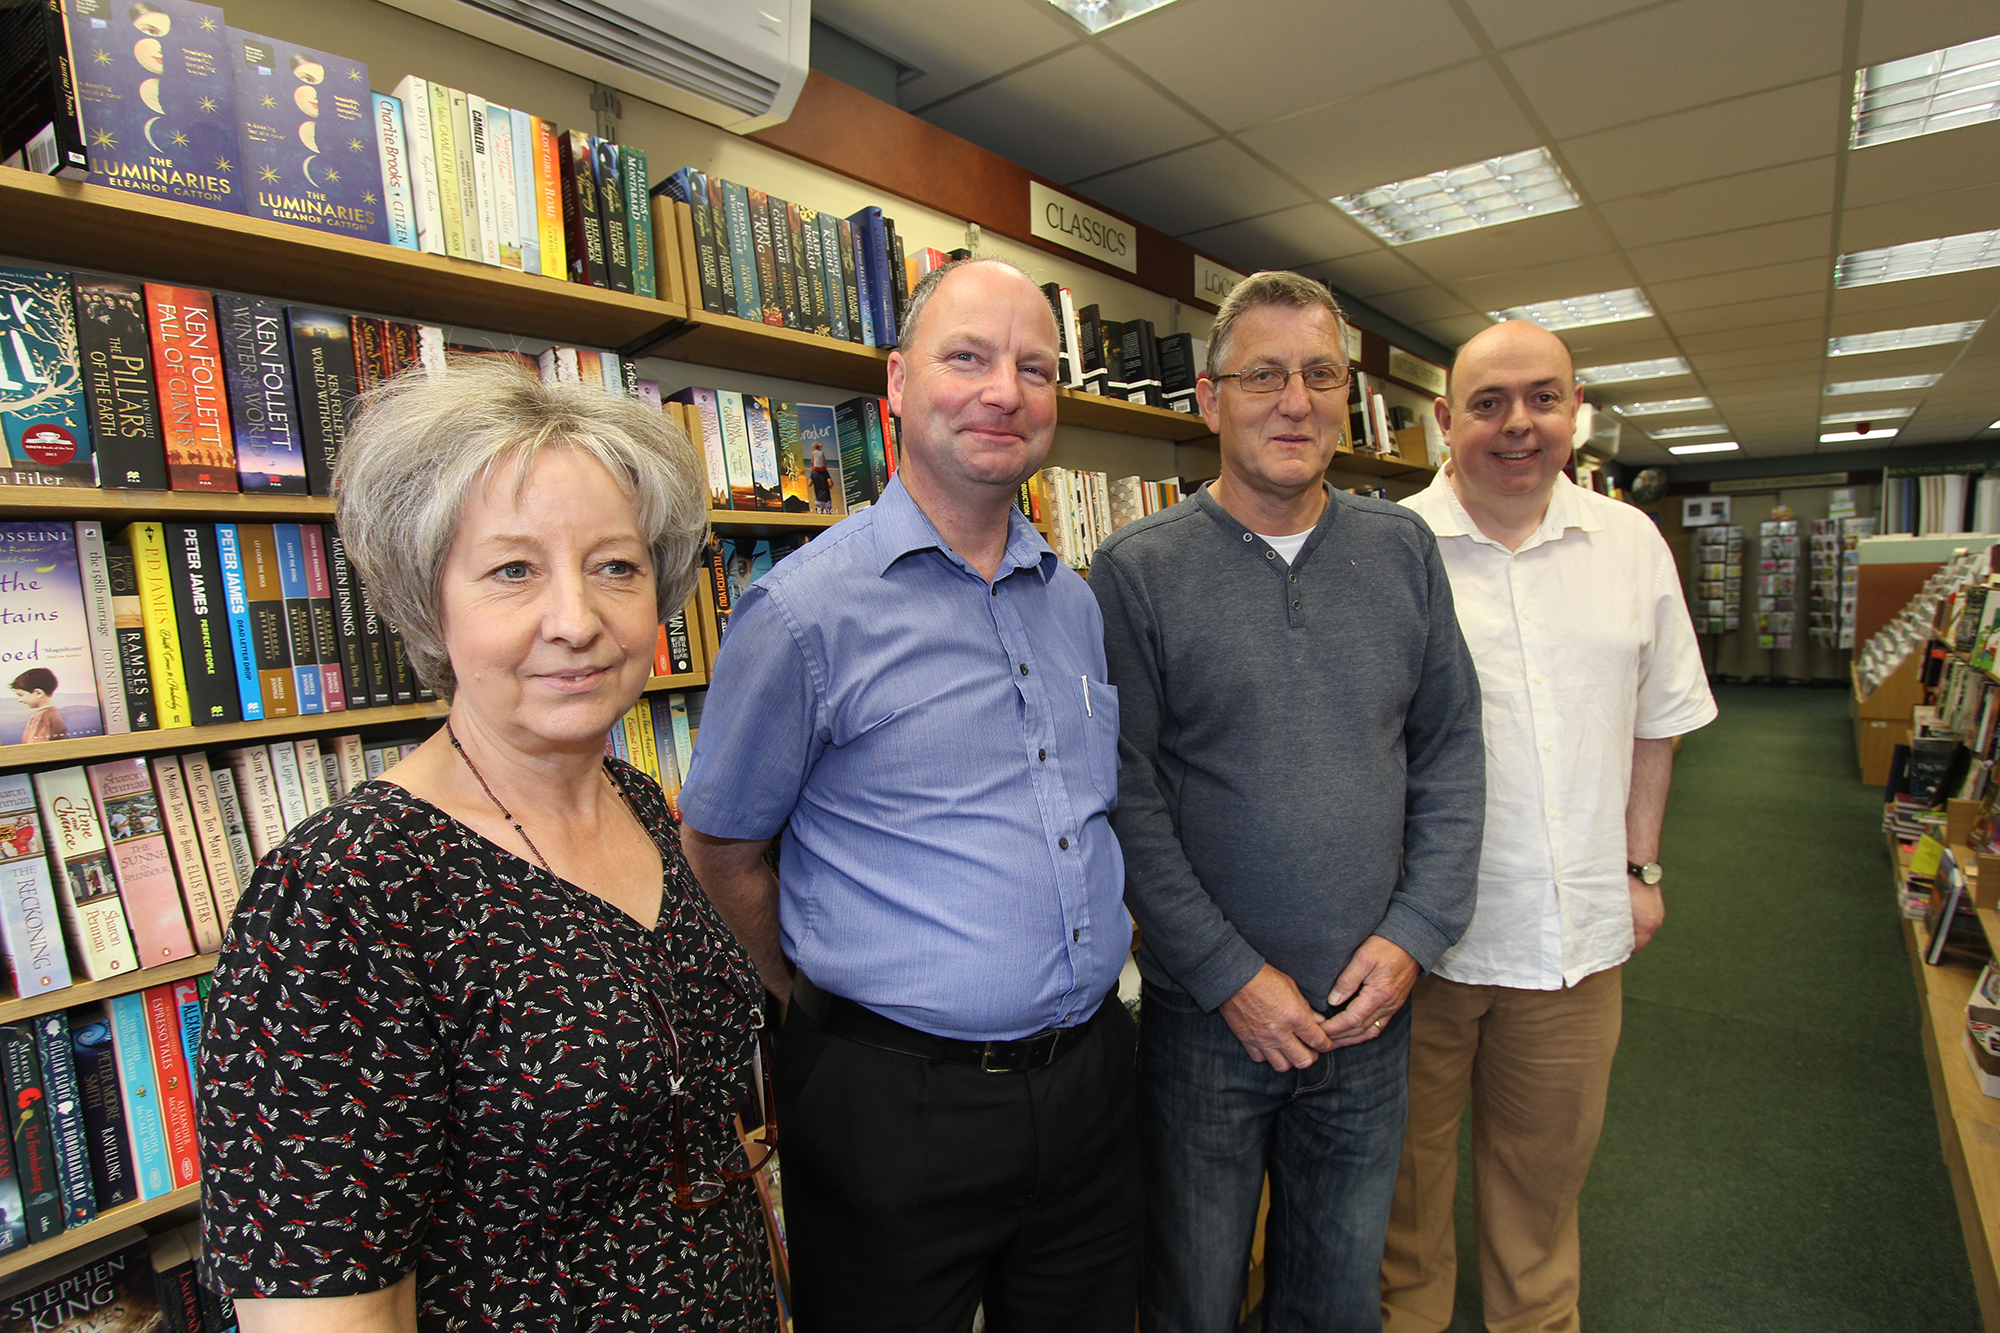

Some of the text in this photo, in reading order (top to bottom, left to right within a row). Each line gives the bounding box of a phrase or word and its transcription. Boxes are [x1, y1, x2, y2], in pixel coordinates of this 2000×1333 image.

[416, 106, 429, 142] BYATT
[472, 110, 485, 155] CAMILLERI
[93, 158, 232, 195] LUMINARIES
[148, 156, 173, 168] THE
[380, 100, 408, 244] Charlie Brooks CITIZEN
[541, 132, 556, 219] LOST GIRLS ROME
[109, 177, 222, 202] ELEANOR CATTON
[258, 191, 375, 225] LUMINARIES
[306, 190, 326, 202] THE
[627, 156, 640, 220] MONTABARD
[637, 170, 648, 217] FALCONS
[272, 208, 368, 232] ELEANOR CATTON
[584, 217, 594, 261] CHADWICK
[590, 217, 603, 265] ELIZABETH
[609, 220, 619, 263] CHADWICK
[729, 194, 743, 254] WHITE CASTLE
[737, 202, 747, 236] LORDS
[754, 220, 765, 253] KING
[761, 217, 771, 247] DEFY
[773, 208, 786, 264] COURAGE
[1046, 202, 1127, 256] CLASSICS
[615, 221, 626, 267] ELIZABETH
[635, 224, 645, 272] CHADWICK
[701, 245, 712, 285] CHADWICK
[804, 224, 816, 269] ENGLISH
[812, 230, 822, 260] LADY
[823, 229, 836, 276] KNIGHT
[707, 246, 717, 288] ELIZABETH
[740, 259, 750, 304] CHADWICK
[761, 257, 771, 302] CHADWICK
[233, 306, 257, 376] WINTER
[90, 351, 117, 437] OF THE EARTH
[109, 337, 147, 438] THE PILLARS
[158, 304, 196, 447] FALL OF GIANTS
[183, 306, 223, 448] KEN FOLLETT
[254, 315, 292, 451] KEN FOLLETT
[312, 347, 334, 448] WORLD WITHOUT
[327, 374, 339, 396] KEN
[244, 392, 269, 457] WORLD
[707, 412, 718, 435] DIANA
[723, 407, 736, 445] GABALDON
[733, 416, 742, 437] DIANA
[751, 410, 762, 448] GABALDON
[760, 419, 769, 441] DIANA
[776, 410, 790, 450] GABALDON
[786, 419, 797, 442] DIANA
[14, 472, 64, 486] Filer
[107, 556, 126, 591] JACQ
[332, 537, 355, 637] MAUREEN JENNINGS
[714, 555, 728, 607] I'LL CATCH YOU
[149, 577, 170, 625] JAMES
[184, 529, 215, 675] PETER JAMES PERFECT PEOPLE
[220, 529, 252, 680] PETER JAMES DEAD LETTER DROP
[90, 552, 123, 722] the 158lb marriage JOHN IRVING
[127, 632, 148, 695] RAMSES
[104, 771, 144, 785] Sharon
[250, 751, 273, 822] Saint Fair
[277, 746, 294, 788] The Leper
[303, 742, 319, 786] The Virgin
[665, 753, 679, 820] Shadow Banyan
[102, 780, 150, 795] Penman
[191, 764, 230, 886] One Corpse Too Many ELLIS
[121, 849, 168, 870] SUNNE
[164, 774, 212, 923] Morbid Taste Bones ELLIS PETERS
[10, 865, 38, 878] THE
[124, 866, 171, 884] SPLENDOUR
[16, 879, 51, 970] RECKONING
[86, 909, 106, 953] Penman
[102, 908, 122, 947] Sharon
[130, 1034, 140, 1061] WORLD
[153, 997, 173, 1070] ESPRESSO TALES
[8, 1040, 22, 1091] SEDGWICK
[19, 1042, 32, 1084] MARCUS
[125, 1059, 136, 1082] BERTIE
[84, 1074, 101, 1109] SMITH
[97, 1051, 120, 1122] PETER MOORE
[49, 1040, 87, 1201] GILLIAN SLOVO HONOURABLE MAN
[136, 1104, 152, 1164] McCALL SMITH
[145, 1108, 160, 1156] ALEXANDER
[168, 1096, 184, 1154] McCALL SMITH
[177, 1099, 192, 1146] ALEXANDER
[100, 1126, 122, 1182] RAVELLING
[10, 1254, 126, 1320] STEPHEN
[30, 1281, 115, 1333] KING
